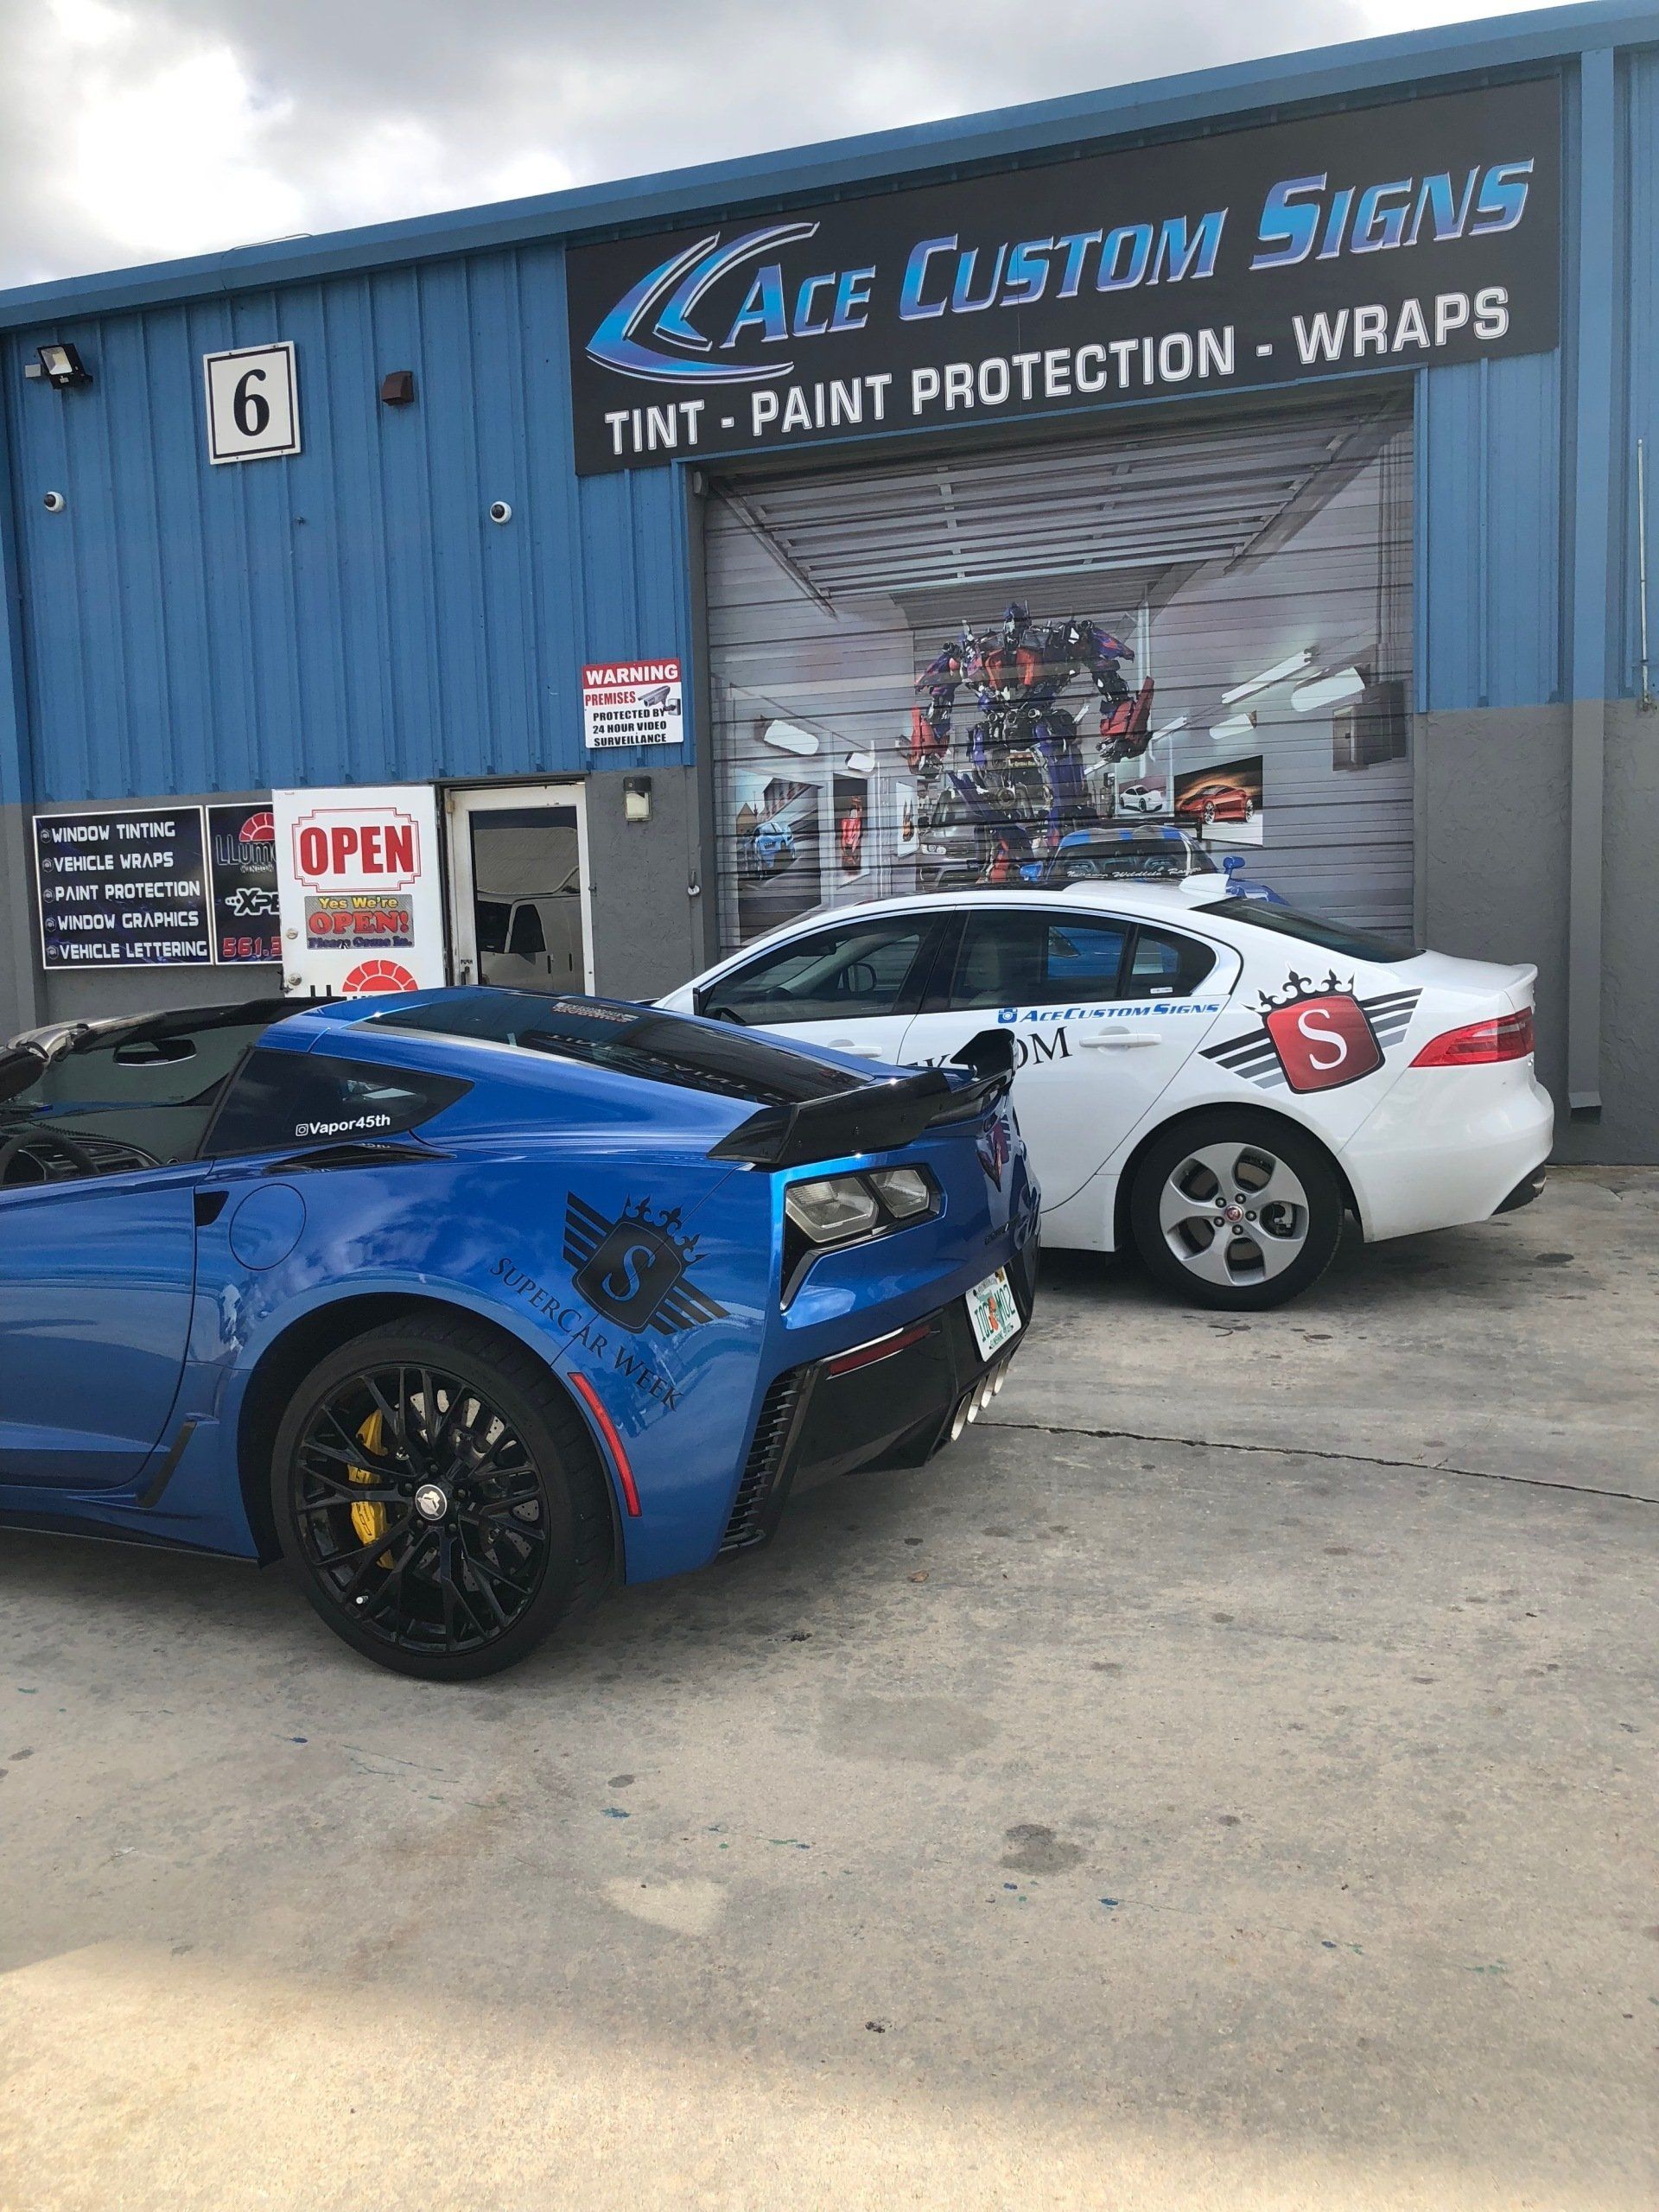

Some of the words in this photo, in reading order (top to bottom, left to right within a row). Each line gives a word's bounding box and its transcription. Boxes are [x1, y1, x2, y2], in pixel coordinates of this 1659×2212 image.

[605, 399, 705, 455] TINT
[751, 372, 893, 437] PAINT
[912, 325, 1235, 416] PROTECTION
[1293, 286, 1509, 365] WRAPS
[233, 369, 270, 436] 6
[586, 664, 678, 685] WARNING
[585, 691, 636, 707] PREMISES
[593, 709, 651, 721] PROTECTED
[652, 708, 665, 717] BY
[593, 725, 605, 734] 24
[607, 722, 635, 733] HOUR
[637, 721, 667, 731] VIDEO
[594, 734, 667, 747] SURVEILLANCE
[52, 825, 110, 842] WINDOW
[117, 822, 175, 839] TINTING
[300, 826, 414, 875] OPEN
[54, 855, 114, 872] VEHICLE
[120, 851, 174, 869] WRAPS
[55, 885, 99, 901] PAINT
[105, 880, 200, 899] PROTECTION
[319, 898, 347, 909] Yes
[352, 896, 398, 909] We're
[57, 914, 115, 931] WINDOW
[122, 911, 199, 928] GRAPHICS
[308, 910, 409, 935] OPEN!
[60, 943, 120, 959] VEHICLE
[126, 941, 207, 957] LETTERING
[1298, 1008, 1347, 1071] S
[602, 1244, 656, 1301] S
[490, 1257, 608, 1359] SUPERCAR
[613, 1345, 685, 1412] WEEK
